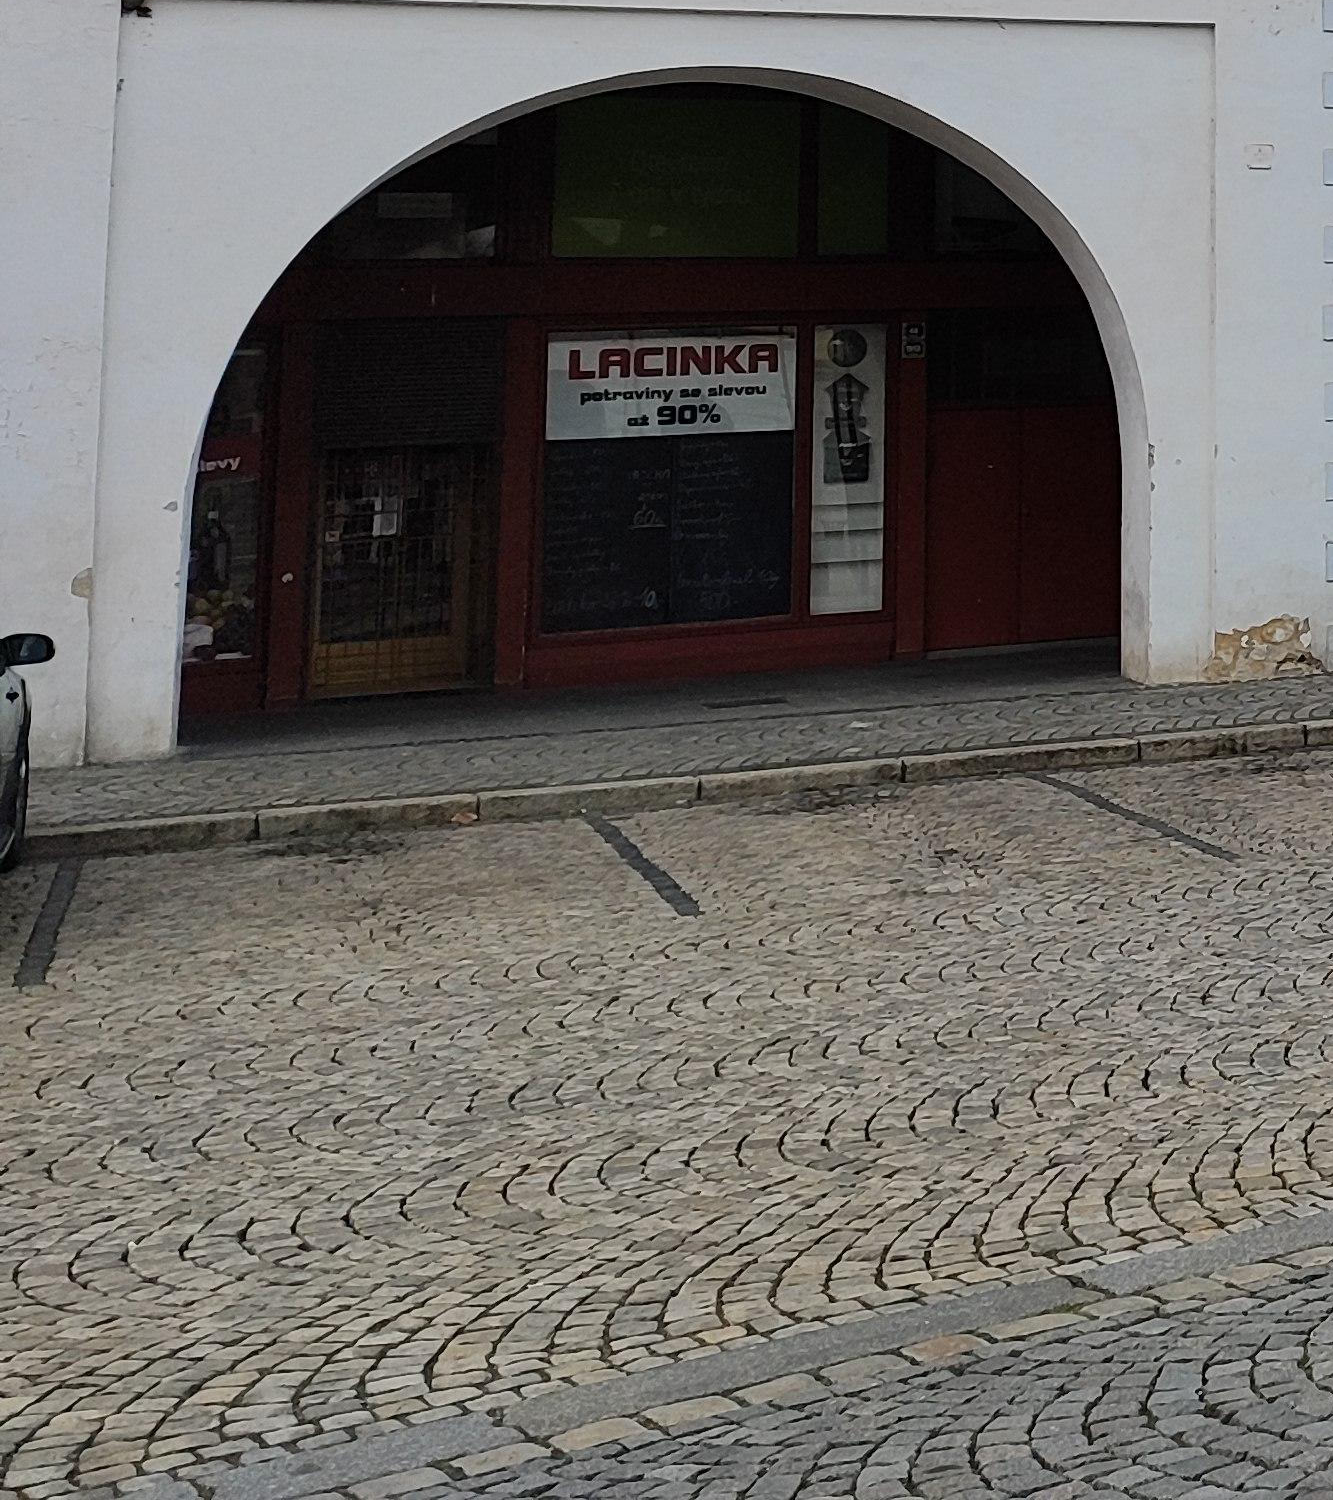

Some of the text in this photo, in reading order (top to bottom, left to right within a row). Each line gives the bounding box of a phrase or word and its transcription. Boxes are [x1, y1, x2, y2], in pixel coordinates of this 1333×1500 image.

[568, 343, 779, 380] LACINKA
[580, 383, 767, 406] potraviny se slevou
[657, 403, 722, 426] 90%
